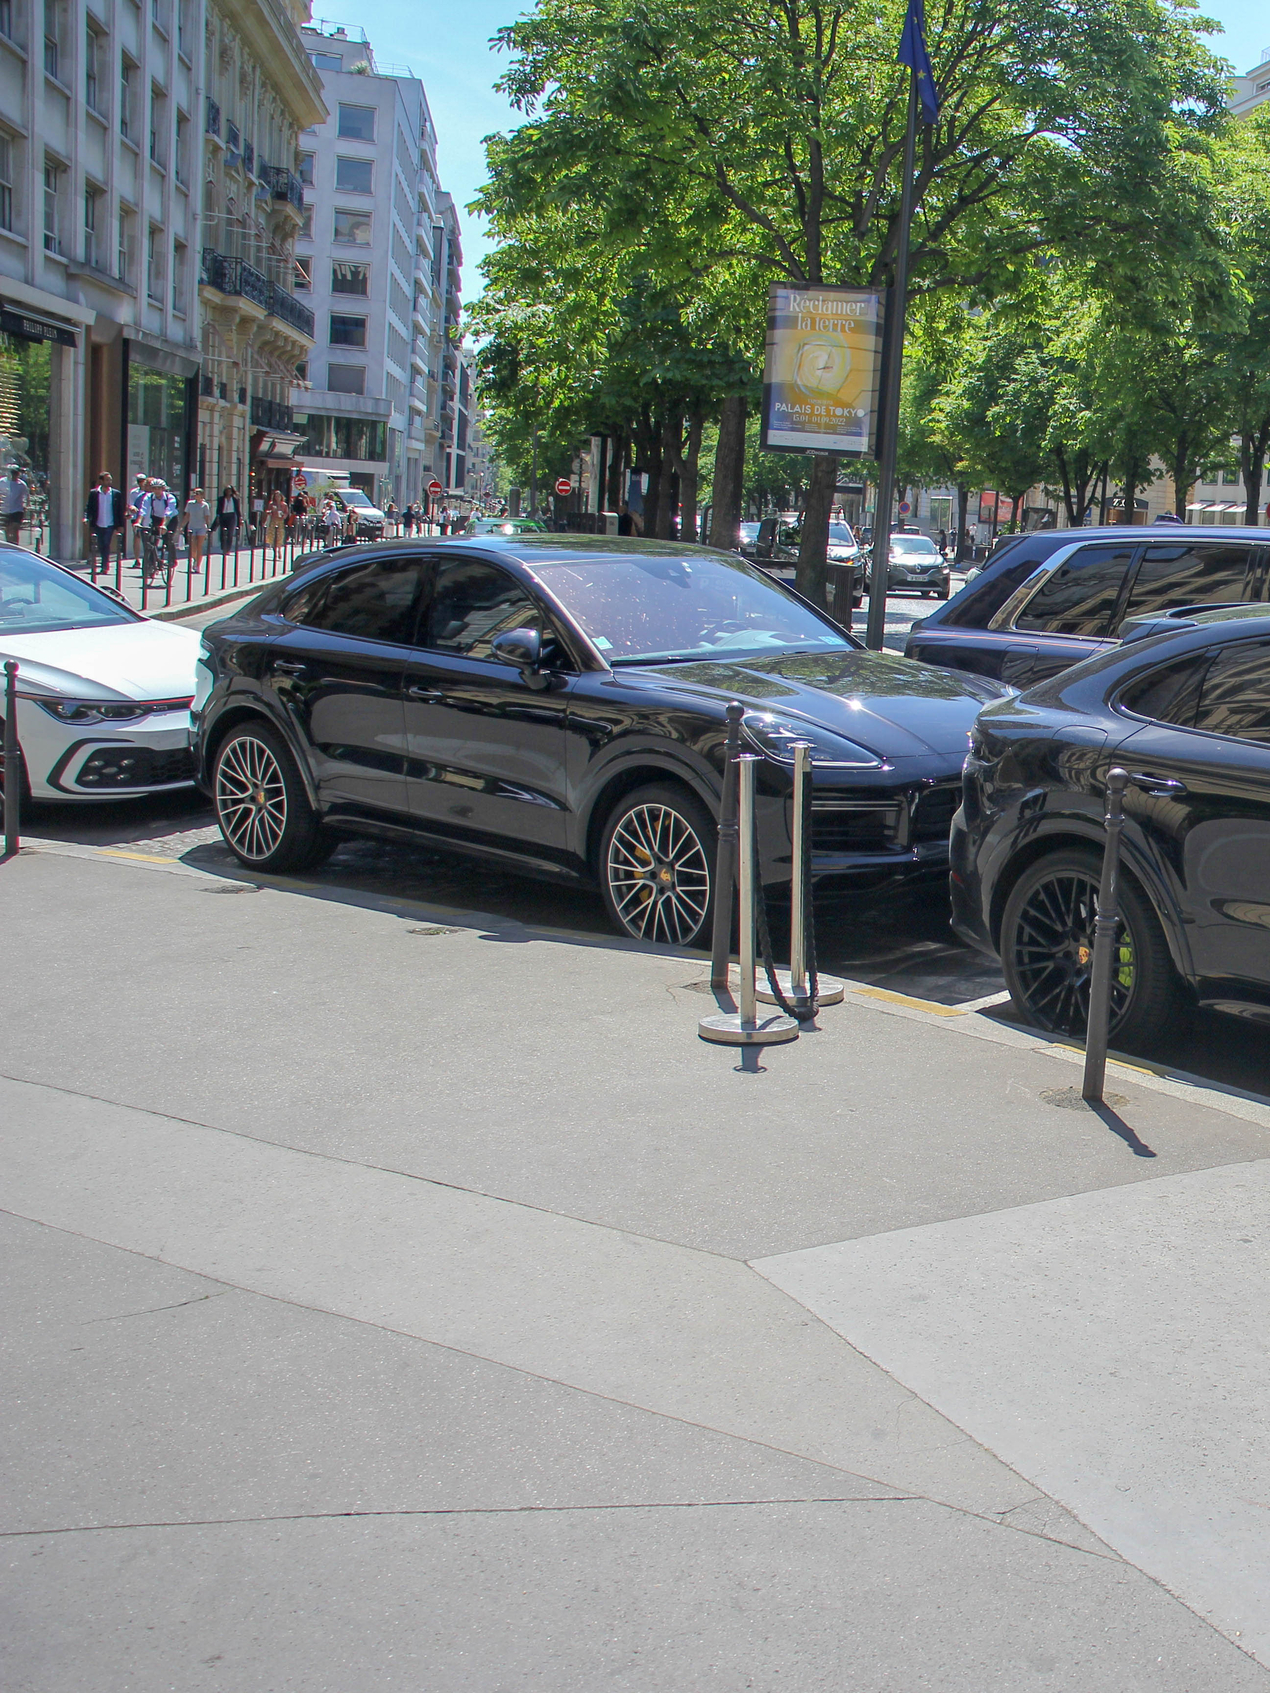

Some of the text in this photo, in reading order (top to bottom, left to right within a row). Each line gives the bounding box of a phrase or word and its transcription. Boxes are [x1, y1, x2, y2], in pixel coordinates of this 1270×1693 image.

[790, 294, 865, 316] Réclamer
[797, 312, 855, 334] la terre
[774, 402, 811, 414] PALAIS
[814, 405, 827, 415] DE
[828, 406, 865, 418] TOKYO
